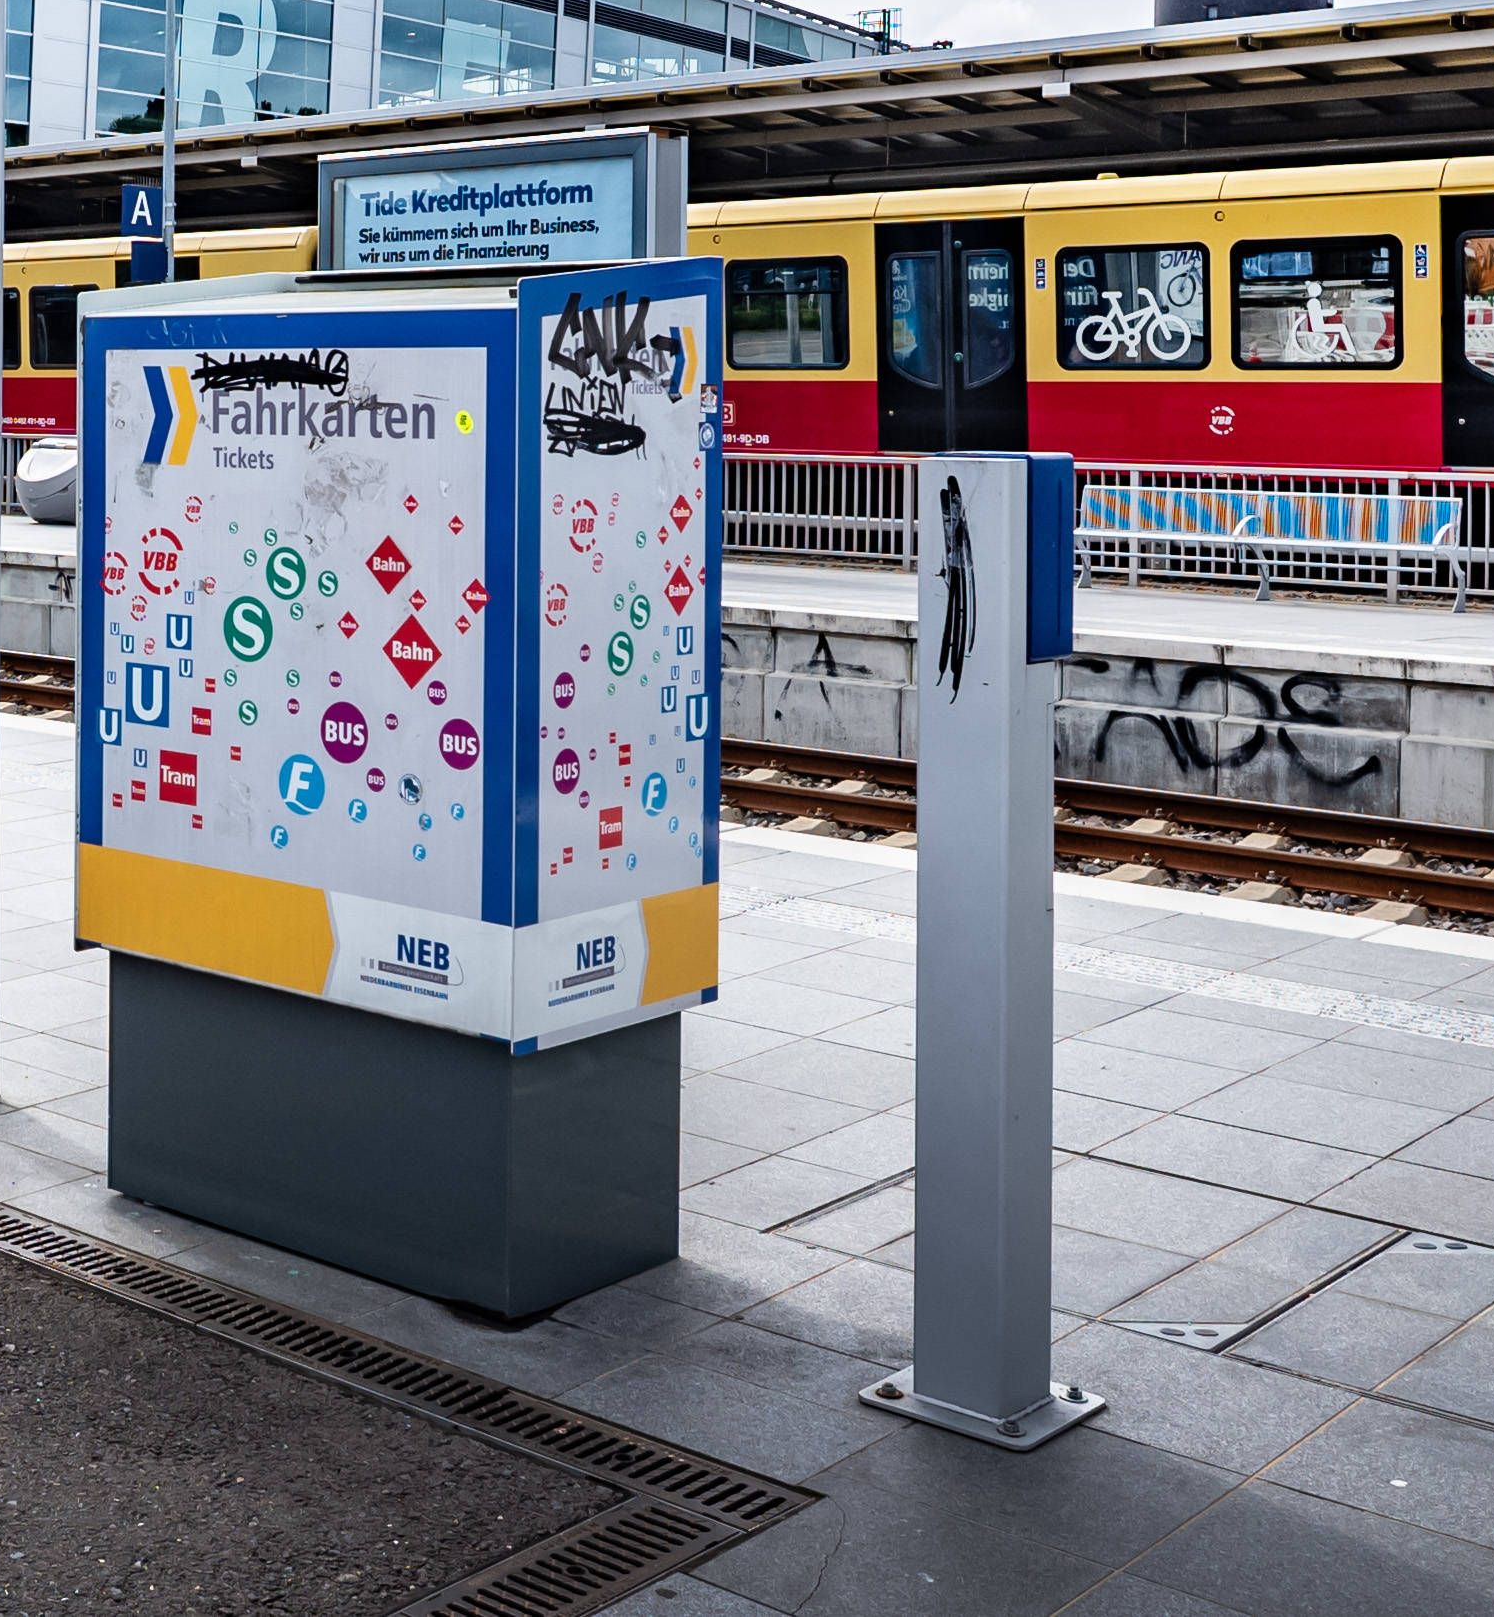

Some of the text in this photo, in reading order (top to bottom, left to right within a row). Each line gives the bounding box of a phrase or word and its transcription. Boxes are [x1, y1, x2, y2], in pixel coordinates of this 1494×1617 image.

[131, 191, 153, 226] A
[360, 180, 592, 217] Tide Kreditplattform
[359, 217, 599, 244] Sie kümmern sich um Ihr Business,
[359, 242, 549, 263] wir uns um die Finanzierung
[631, 379, 662, 394] Tickets
[213, 386, 435, 439] Fahrkarten
[1212, 416, 1232, 425] VBB
[213, 447, 274, 469] Tickets
[673, 508, 690, 518] Bahn
[572, 518, 595, 533] VBB
[143, 551, 178, 571] VBB
[373, 557, 405, 573] Bahn
[103, 567, 125, 580] VBB
[273, 552, 300, 595] S
[323, 573, 334, 595] S
[466, 591, 487, 602] Bahn
[669, 585, 690, 597] Bahn
[547, 598, 566, 611] VBB
[633, 598, 647, 627] S
[170, 617, 189, 647] U
[232, 602, 265, 657] S
[340, 621, 357, 630] Bahn
[392, 640, 433, 662] Bahn
[679, 628, 691, 654] U
[612, 635, 629, 672] S
[181, 660, 191, 676] U
[132, 667, 163, 721] U
[428, 688, 446, 698] BUS
[556, 683, 574, 698] BUS
[663, 688, 675, 711] U
[193, 715, 211, 726] Tram
[241, 703, 255, 723] S
[386, 718, 398, 726] BUS
[690, 696, 708, 738] U
[99, 710, 118, 742] U
[324, 720, 365, 746] BUS
[442, 734, 477, 756] BUS
[161, 765, 196, 787] Tram
[285, 762, 313, 802] F
[368, 775, 385, 785] BUS
[555, 763, 579, 781] BUS
[647, 778, 661, 808] F
[352, 802, 362, 817] F
[274, 829, 284, 844] F
[600, 821, 622, 835] Tram
[397, 934, 450, 971] NEB
[577, 935, 616, 971] NEB
[414, 986, 448, 1000] EISENBAHN
